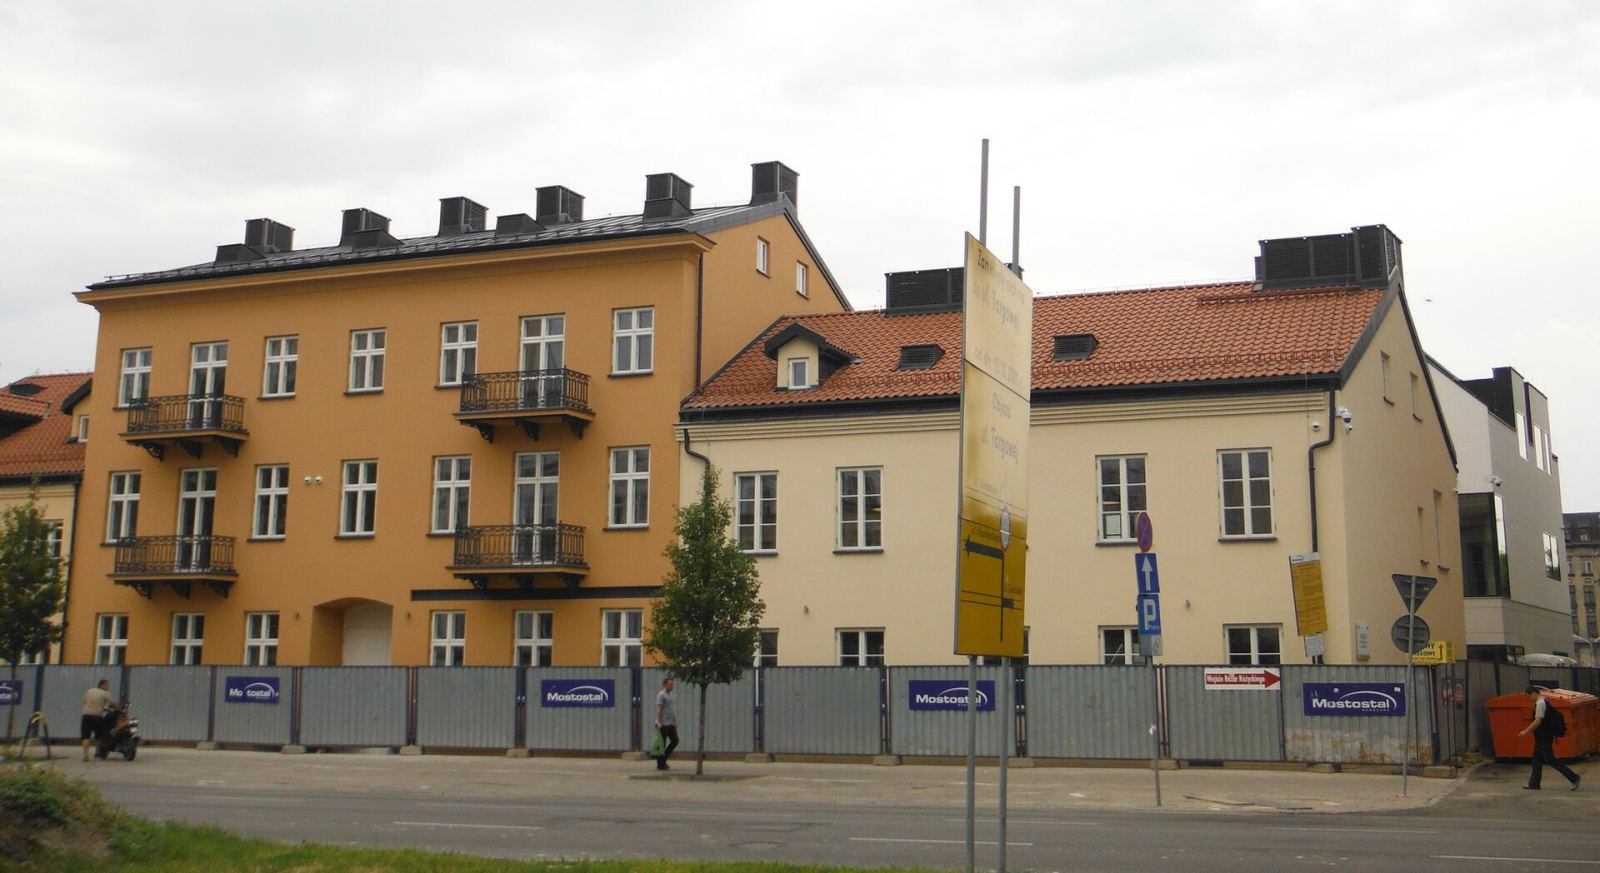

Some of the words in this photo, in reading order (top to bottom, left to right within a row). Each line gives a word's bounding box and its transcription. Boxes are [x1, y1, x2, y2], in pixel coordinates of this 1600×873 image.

[229, 688, 271, 697] Motostal
[547, 692, 604, 702] Mostostal
[915, 694, 981, 704] Mostostl
[1312, 698, 1390, 709] Mostostal
